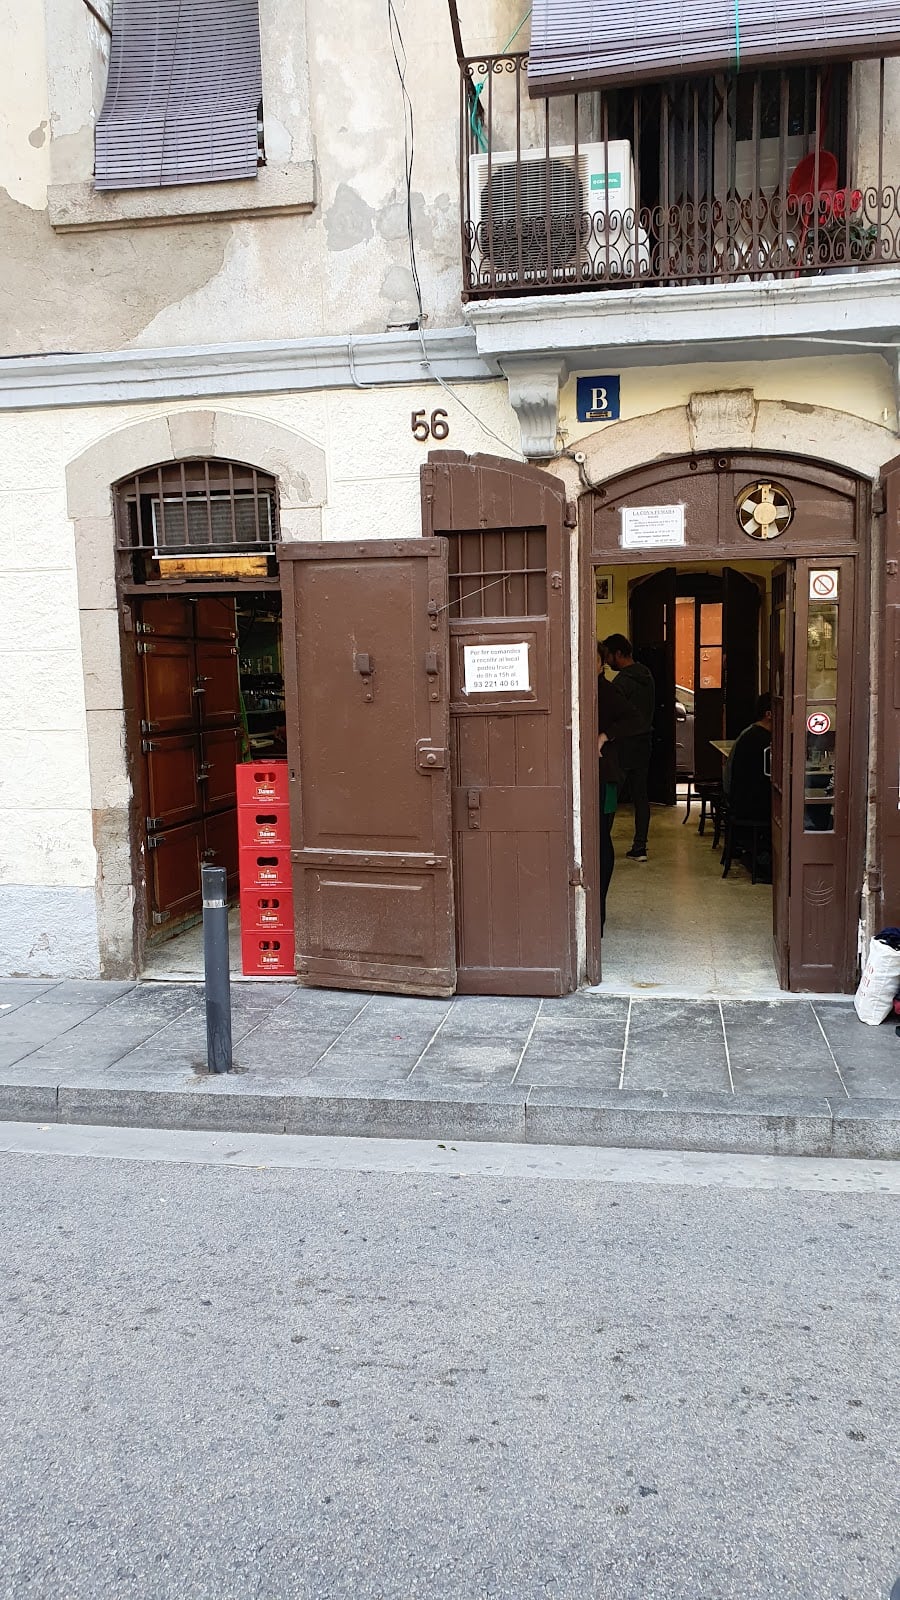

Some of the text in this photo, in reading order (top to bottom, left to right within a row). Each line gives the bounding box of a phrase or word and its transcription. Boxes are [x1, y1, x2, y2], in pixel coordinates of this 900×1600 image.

[589, 387, 608, 410] B
[411, 408, 450, 442] 56
[484, 680, 497, 688] 221
